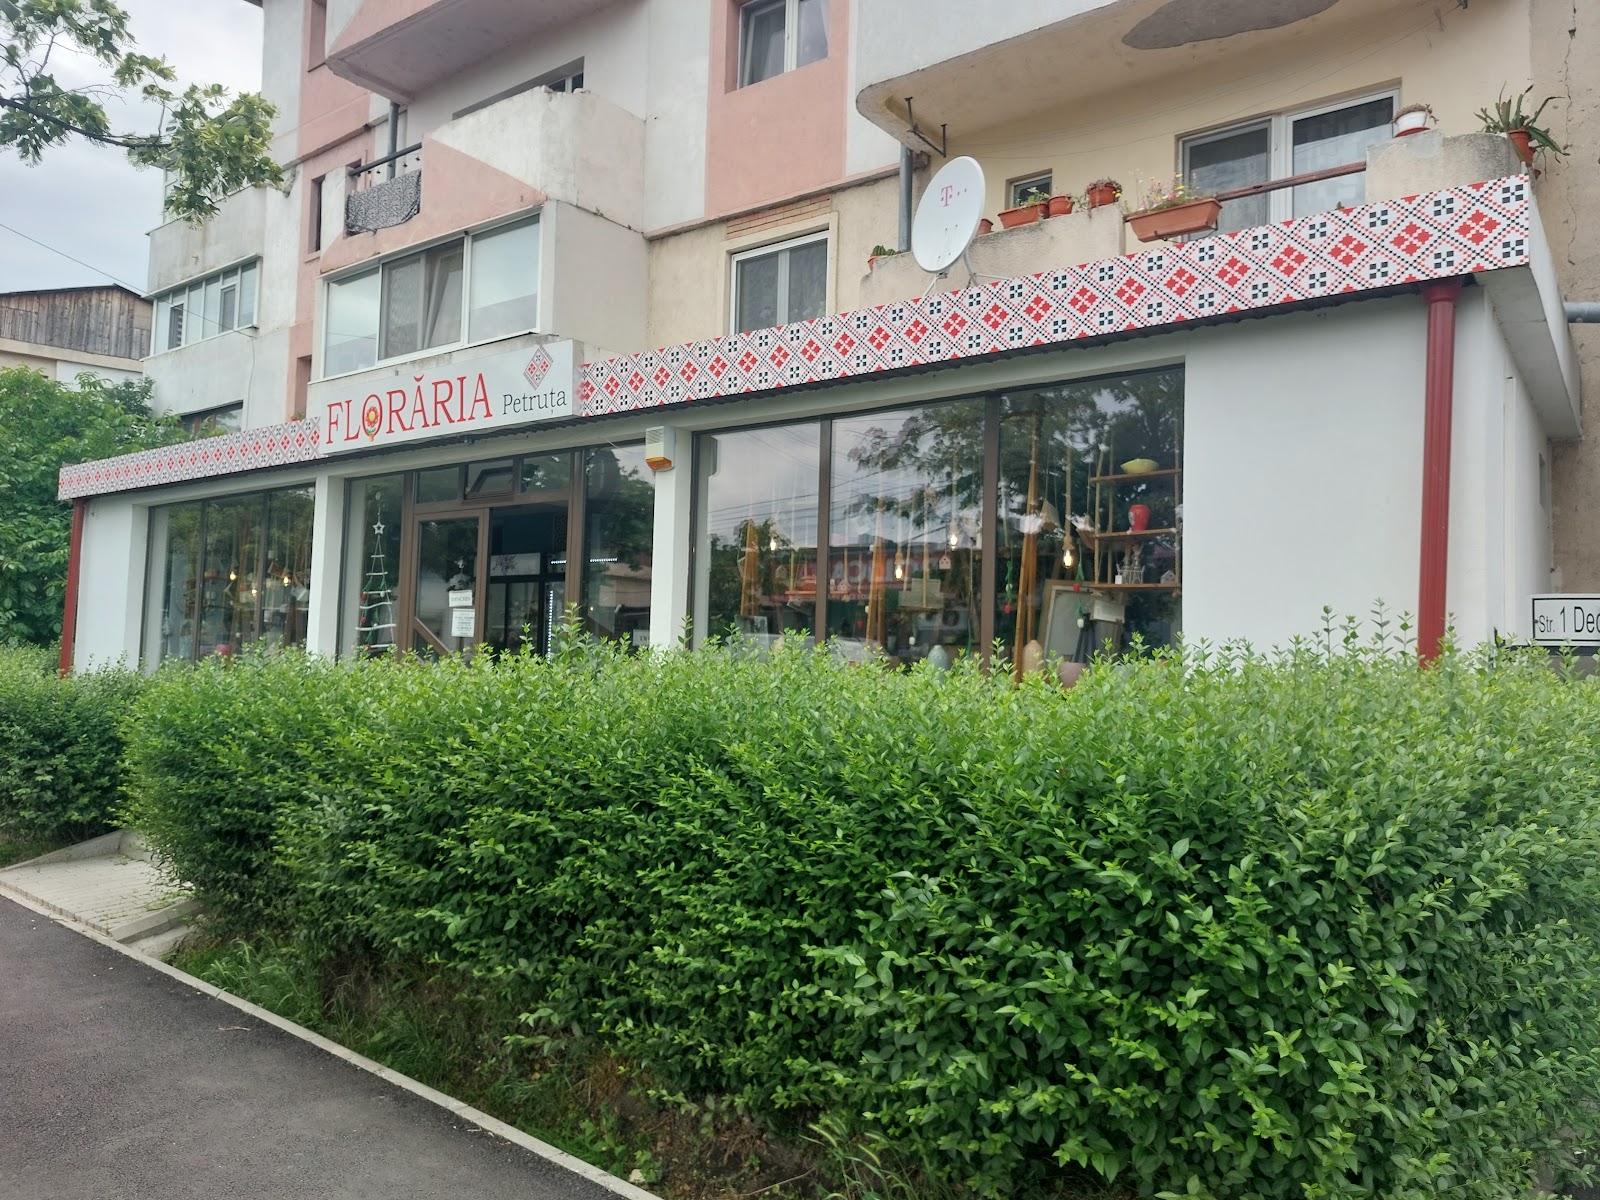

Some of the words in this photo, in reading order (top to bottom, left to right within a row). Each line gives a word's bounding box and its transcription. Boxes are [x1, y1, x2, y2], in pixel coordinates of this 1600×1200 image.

[326, 372, 493, 445] FLORĂRIA
[502, 388, 568, 416] Petruța
[1538, 614, 1556, 633] Str.
[1560, 605, 1566, 633] 1
